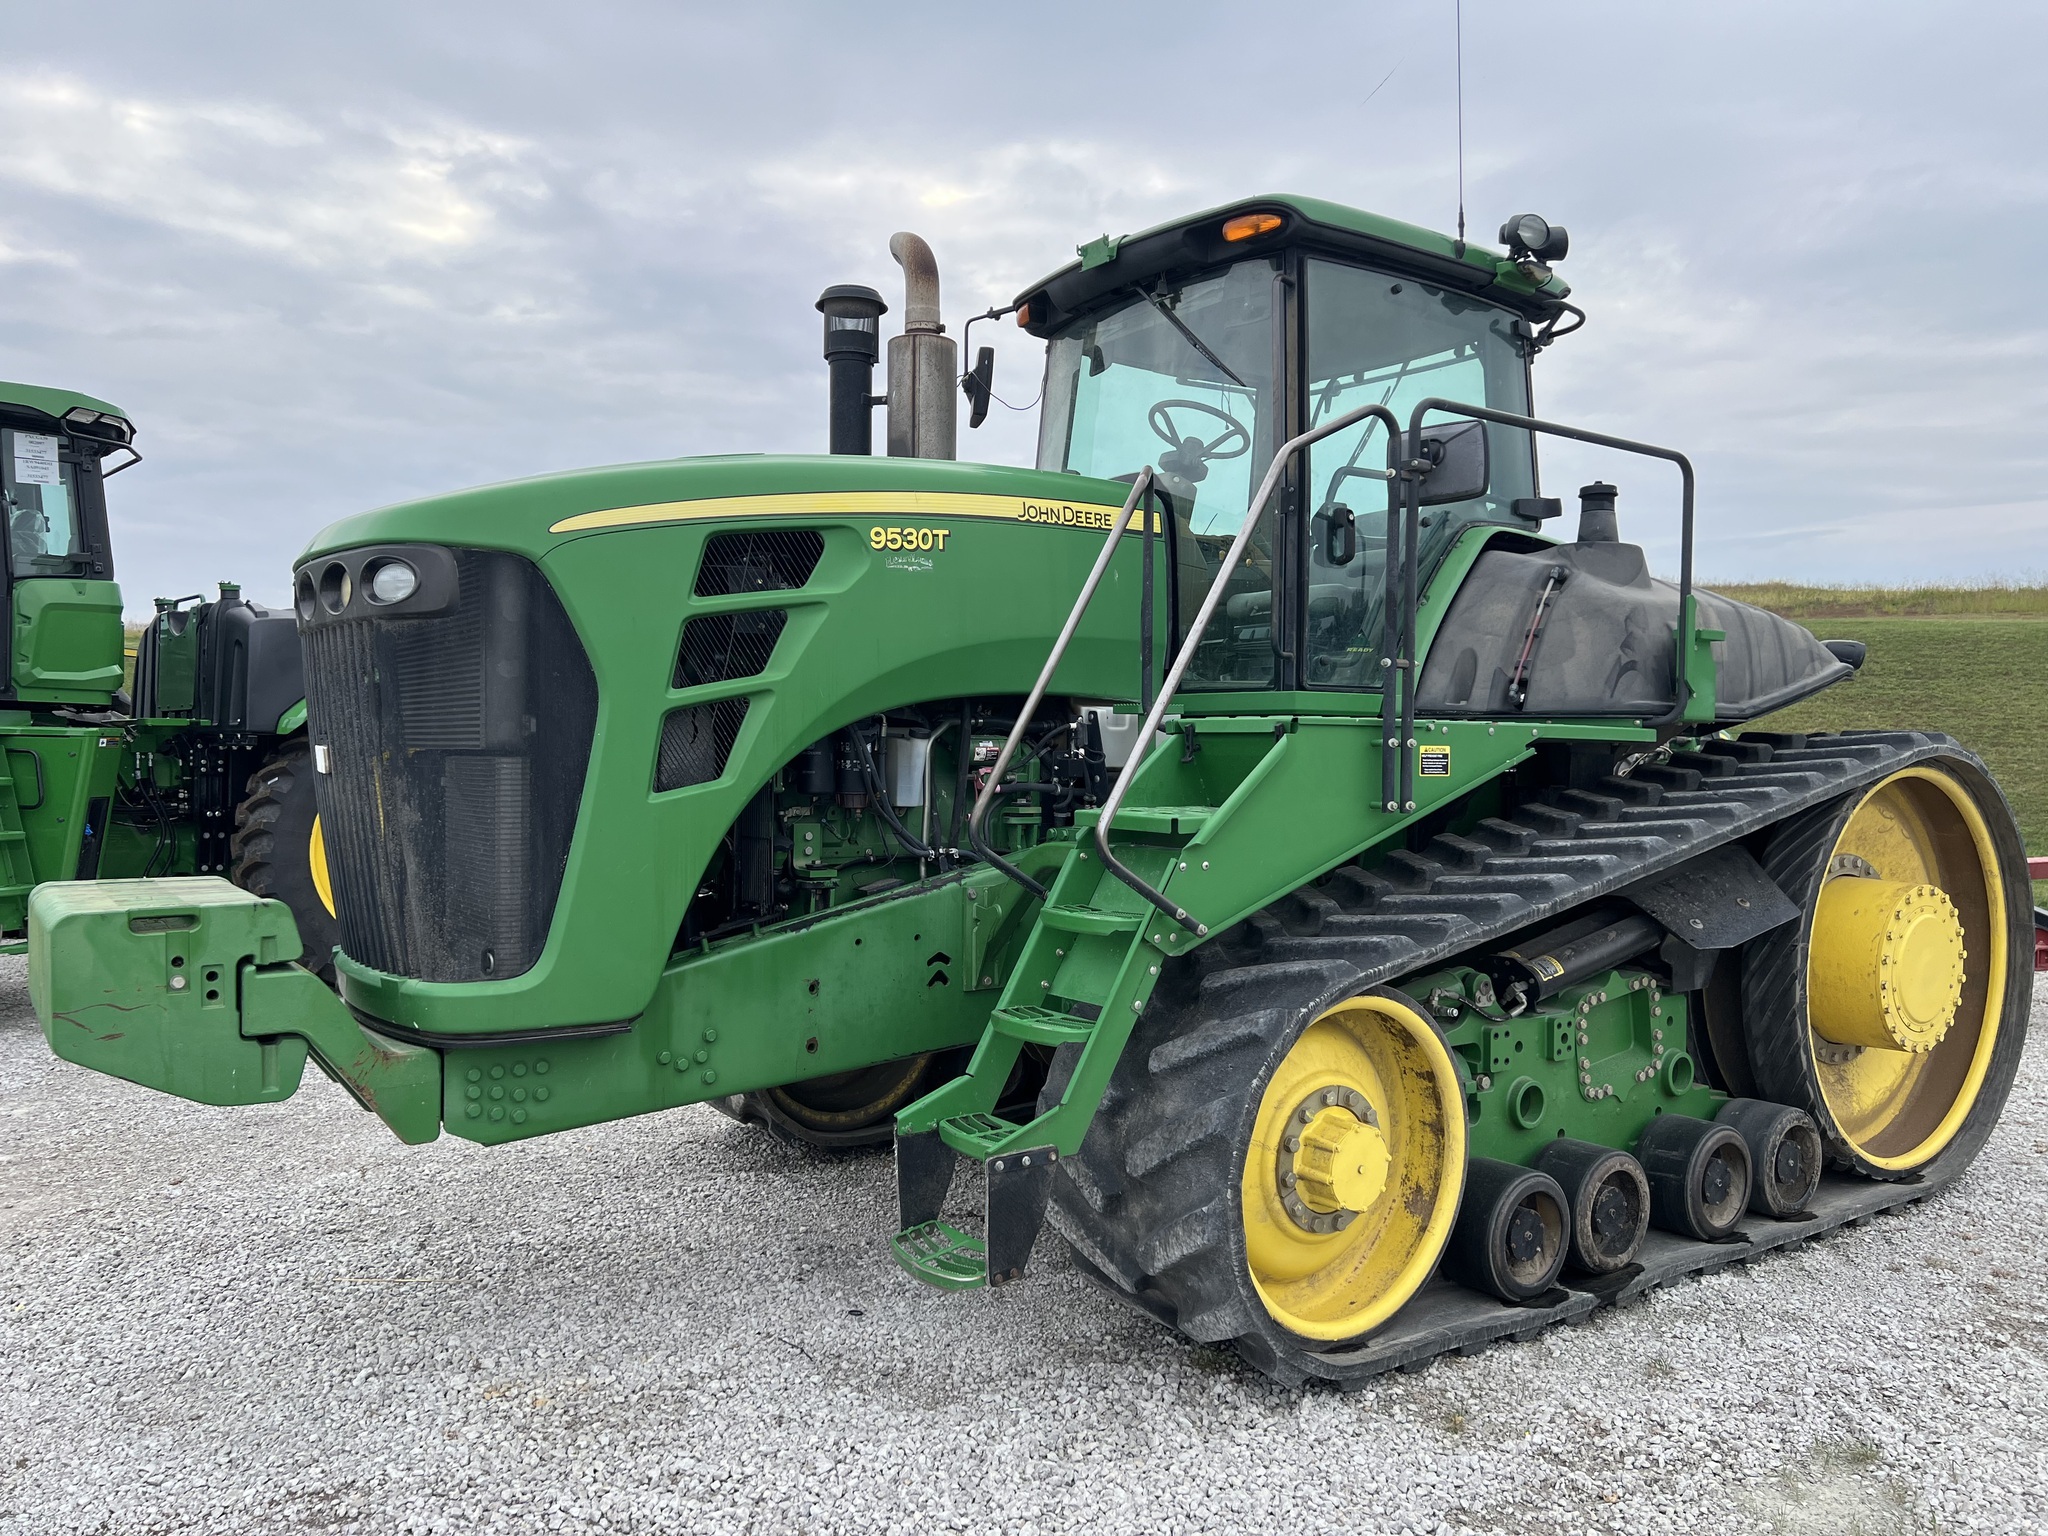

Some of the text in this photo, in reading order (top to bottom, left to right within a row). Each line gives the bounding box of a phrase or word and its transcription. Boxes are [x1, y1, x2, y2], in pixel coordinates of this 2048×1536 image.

[1017, 501, 1113, 528] JOHN DEERE
[869, 526, 951, 552] 9530T
